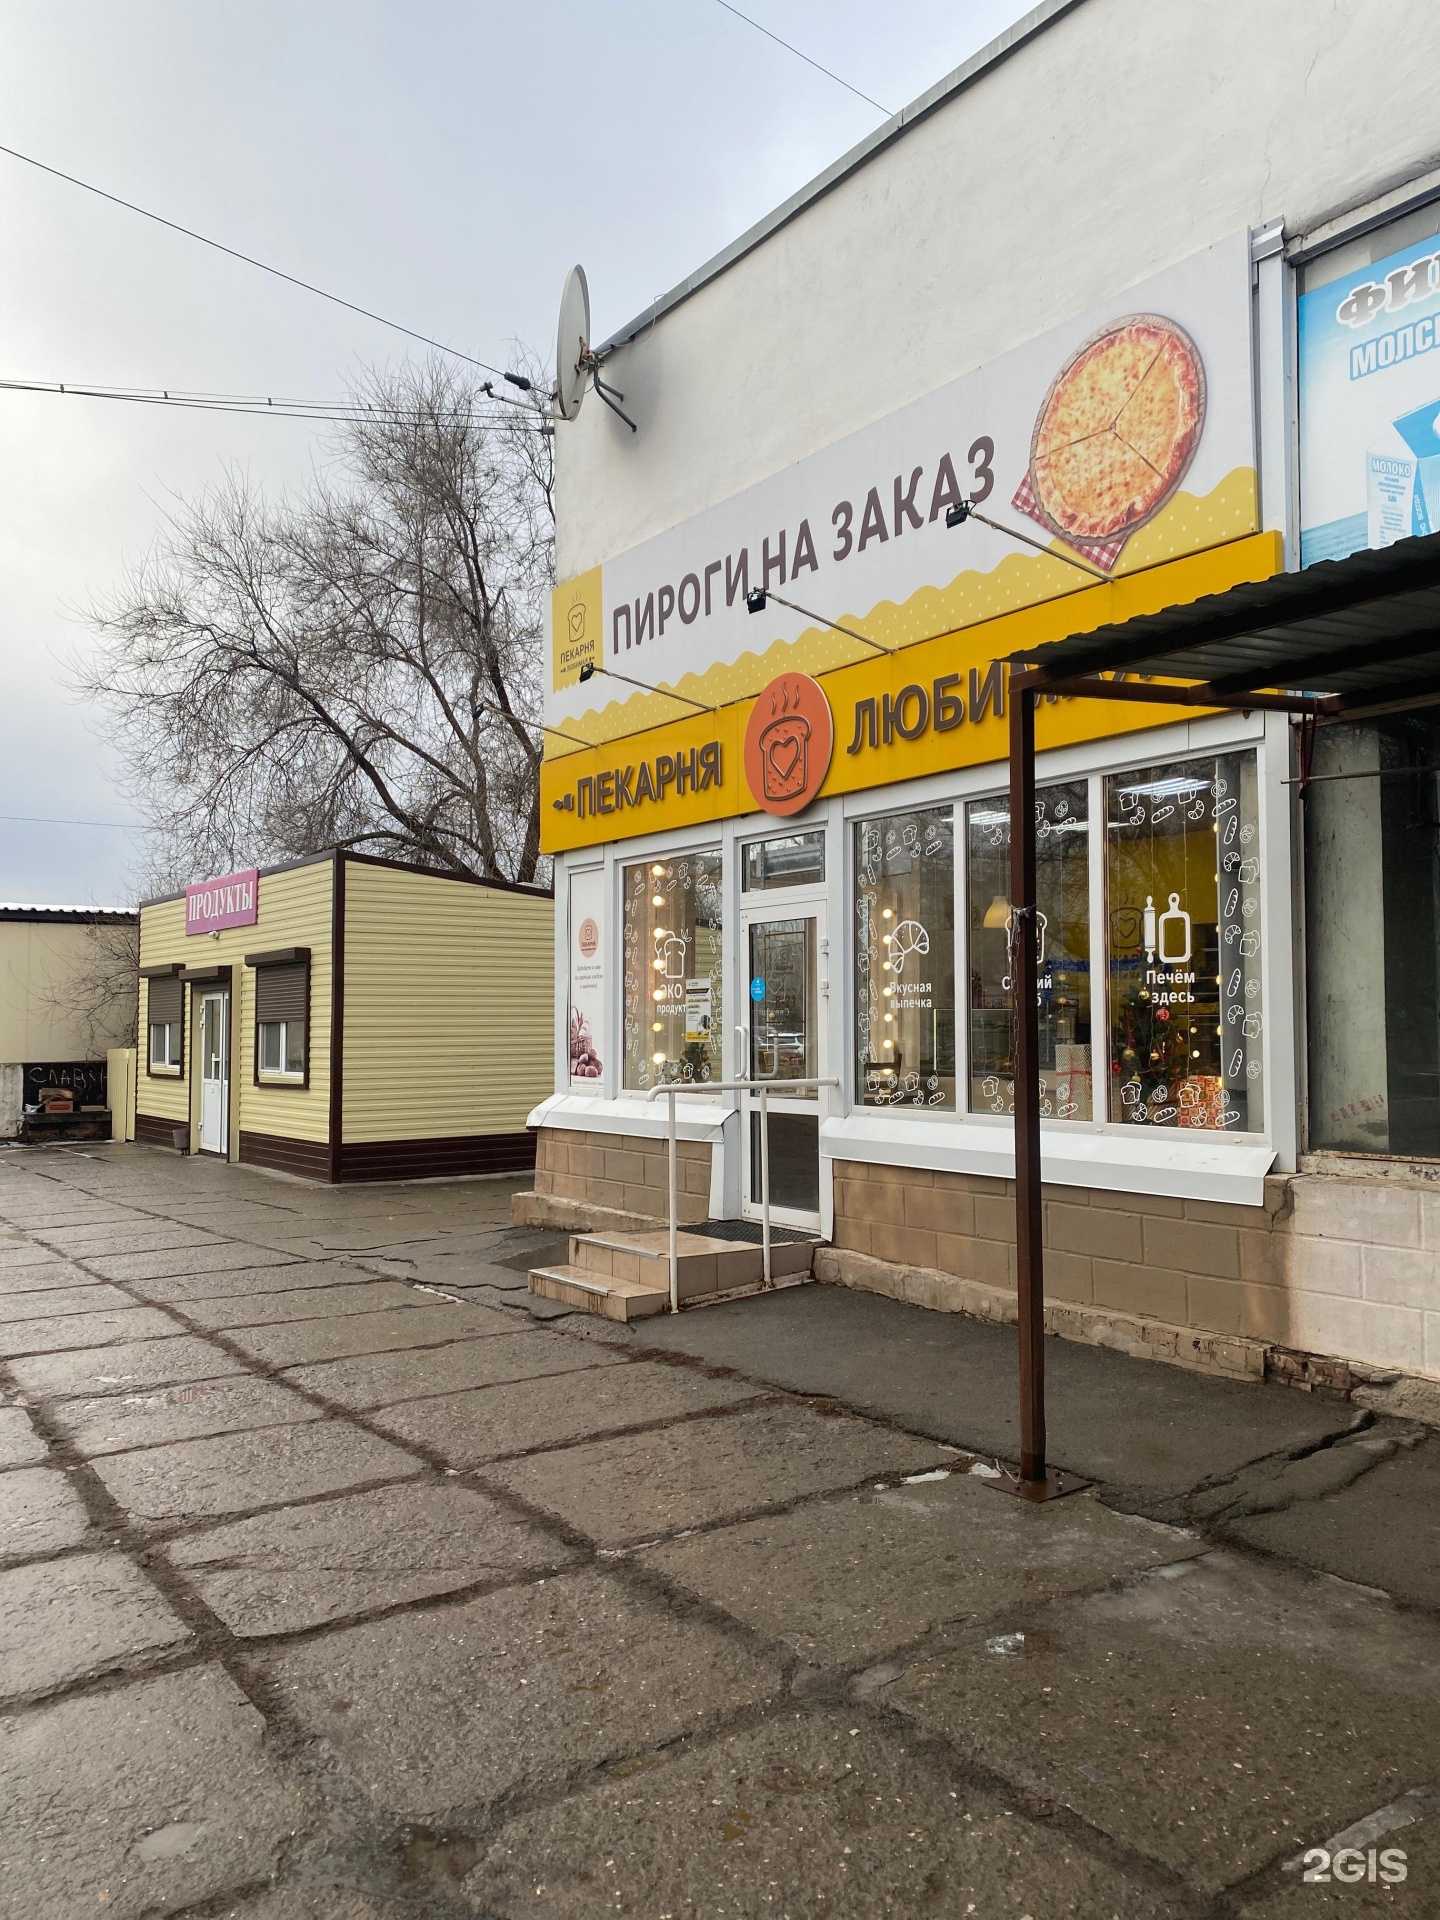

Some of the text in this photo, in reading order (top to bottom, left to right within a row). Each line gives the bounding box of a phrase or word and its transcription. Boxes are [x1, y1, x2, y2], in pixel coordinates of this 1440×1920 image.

[1336, 249, 1440, 328] ФИ
[613, 435, 996, 655] ПИРОГИ НА ЗАКАЗ
[560, 639, 595, 665] ПЕКАРНЯ
[577, 740, 724, 820] ПЕКАРНЯ
[187, 880, 253, 921] ПРОДУКТЫ
[1146, 969, 1195, 985] Печём
[659, 983, 683, 999] ЭКО
[889, 981, 932, 997] Вкусная
[1151, 991, 1195, 1006] здесь
[656, 1003, 687, 1016] продукт
